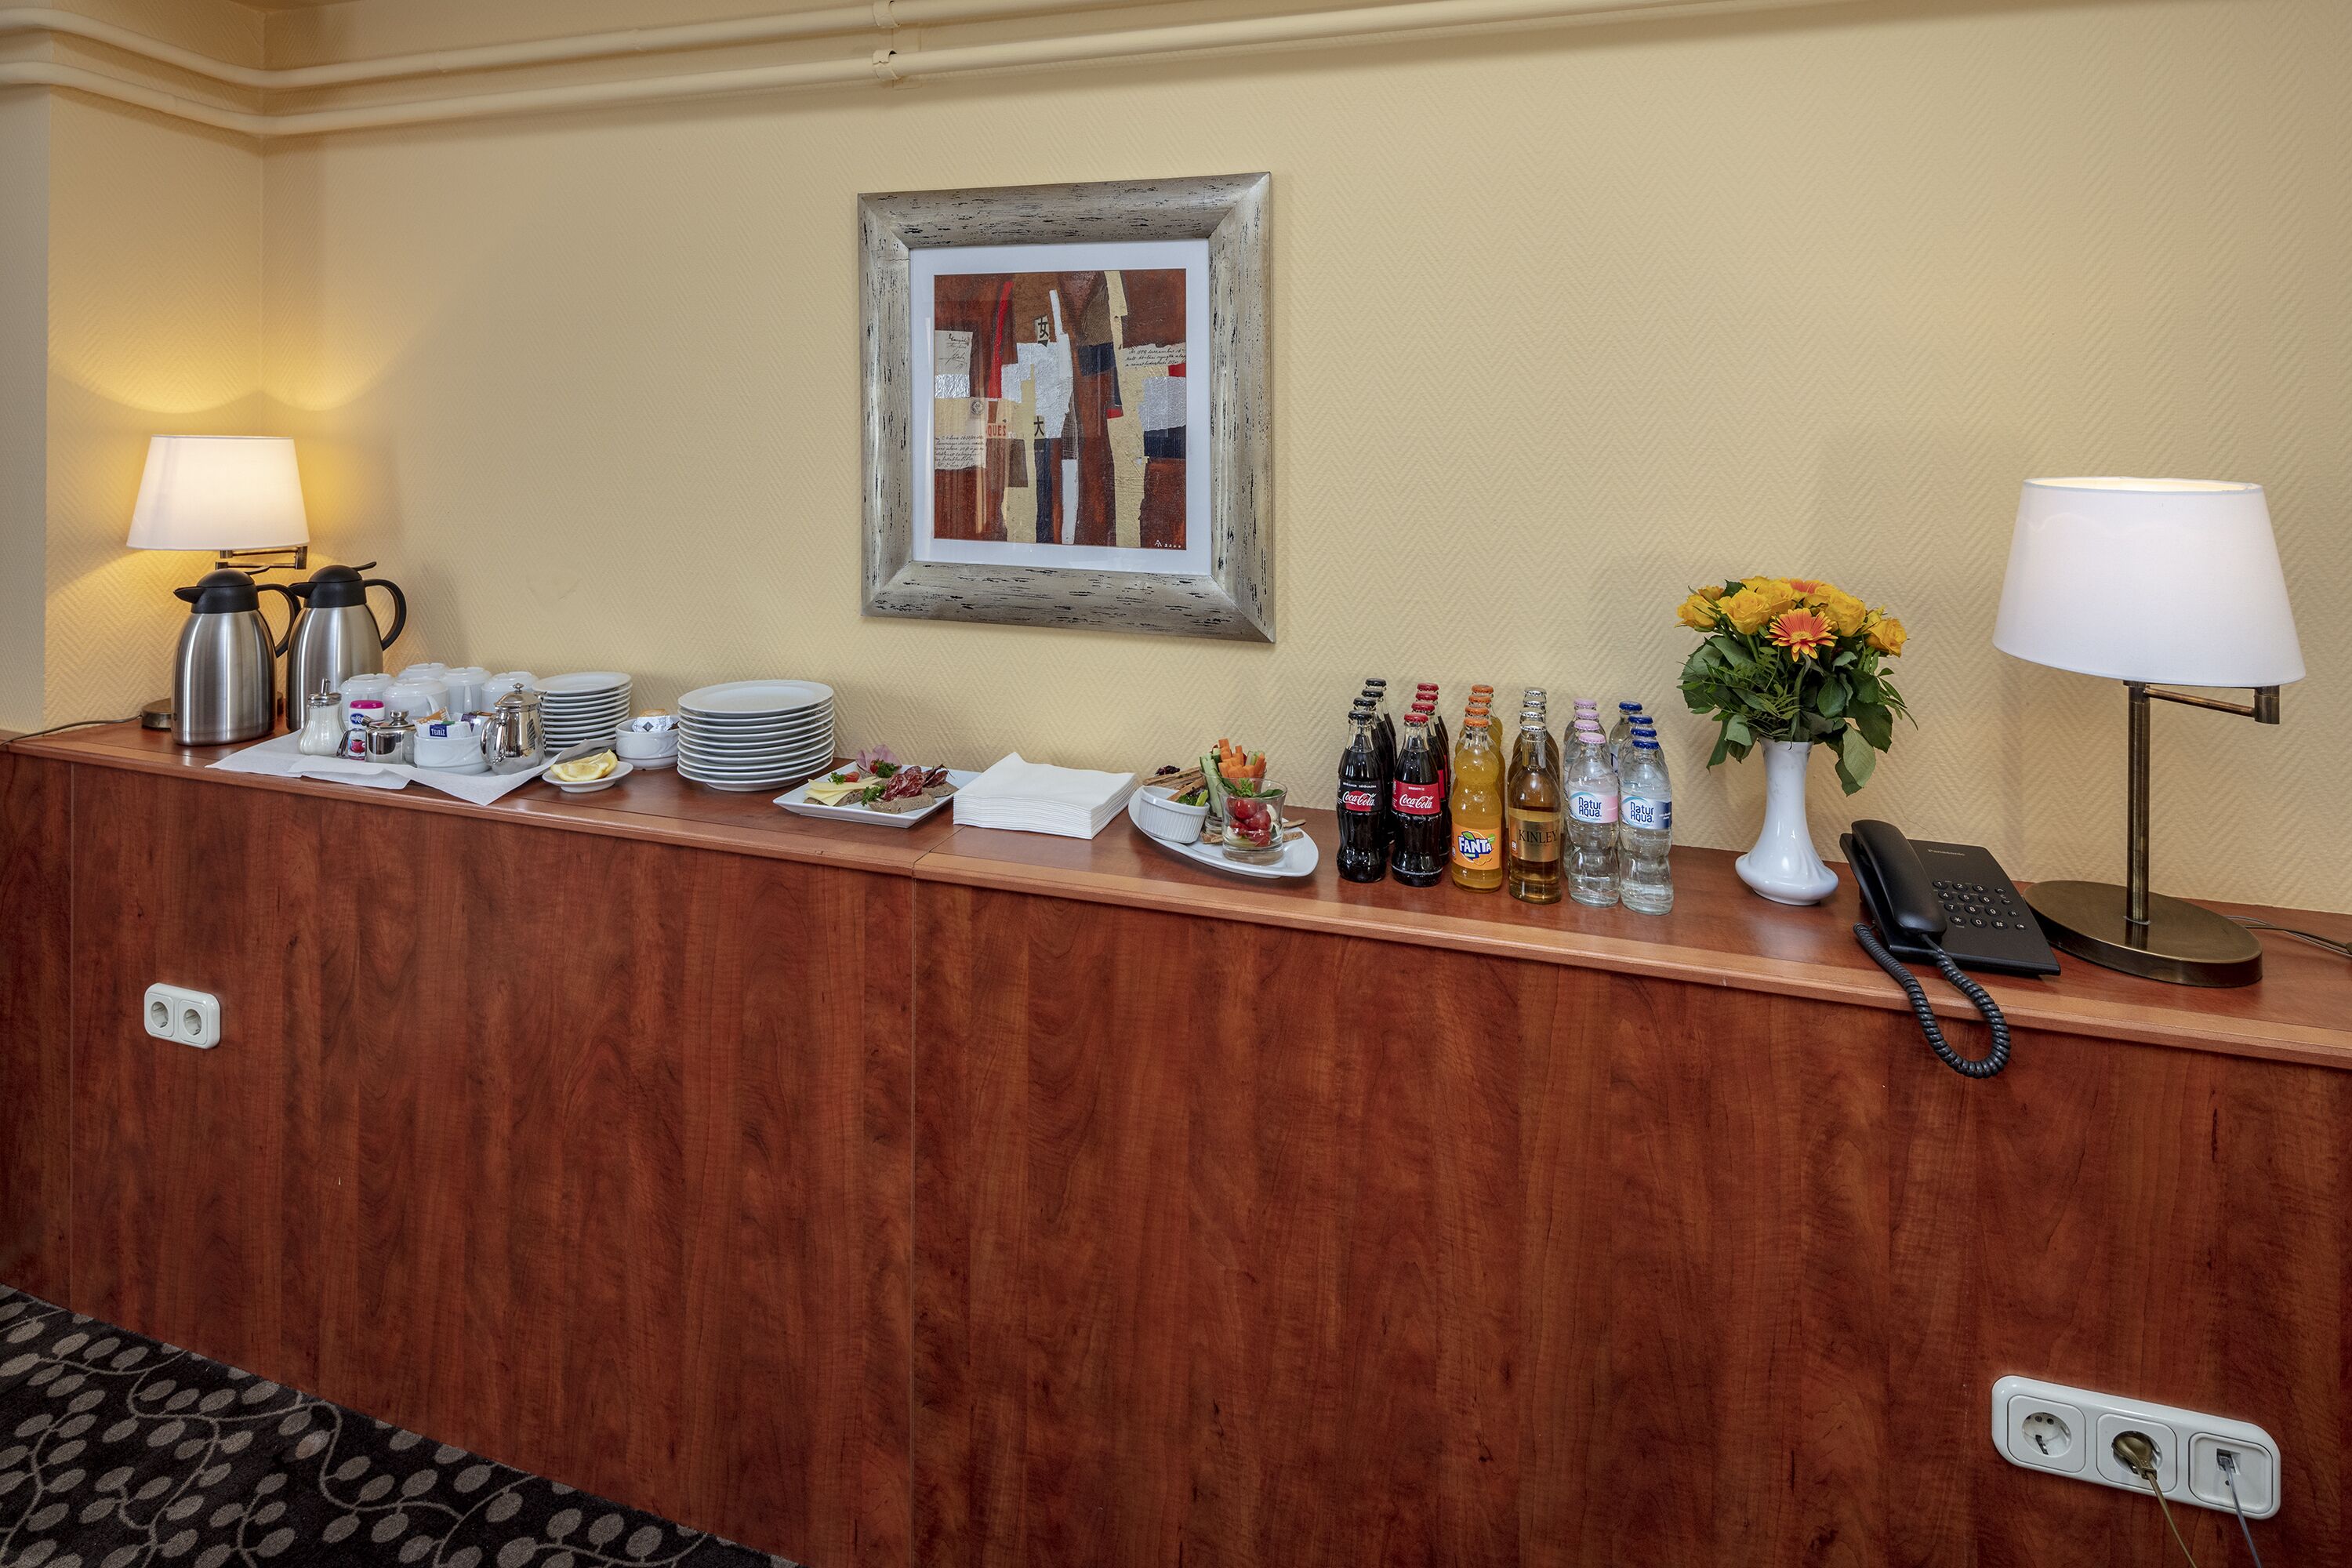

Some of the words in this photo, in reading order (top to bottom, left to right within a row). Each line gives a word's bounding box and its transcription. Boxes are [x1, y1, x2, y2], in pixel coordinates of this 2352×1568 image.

[1038, 318, 1048, 338] 女
[1033, 416, 1044, 437] 大
[1342, 791, 1377, 806] Coca-Cola
[1399, 794, 1434, 808] Coca-Cola
[1458, 836, 1492, 853] FANTA
[1519, 829, 1558, 844] KINLEY
